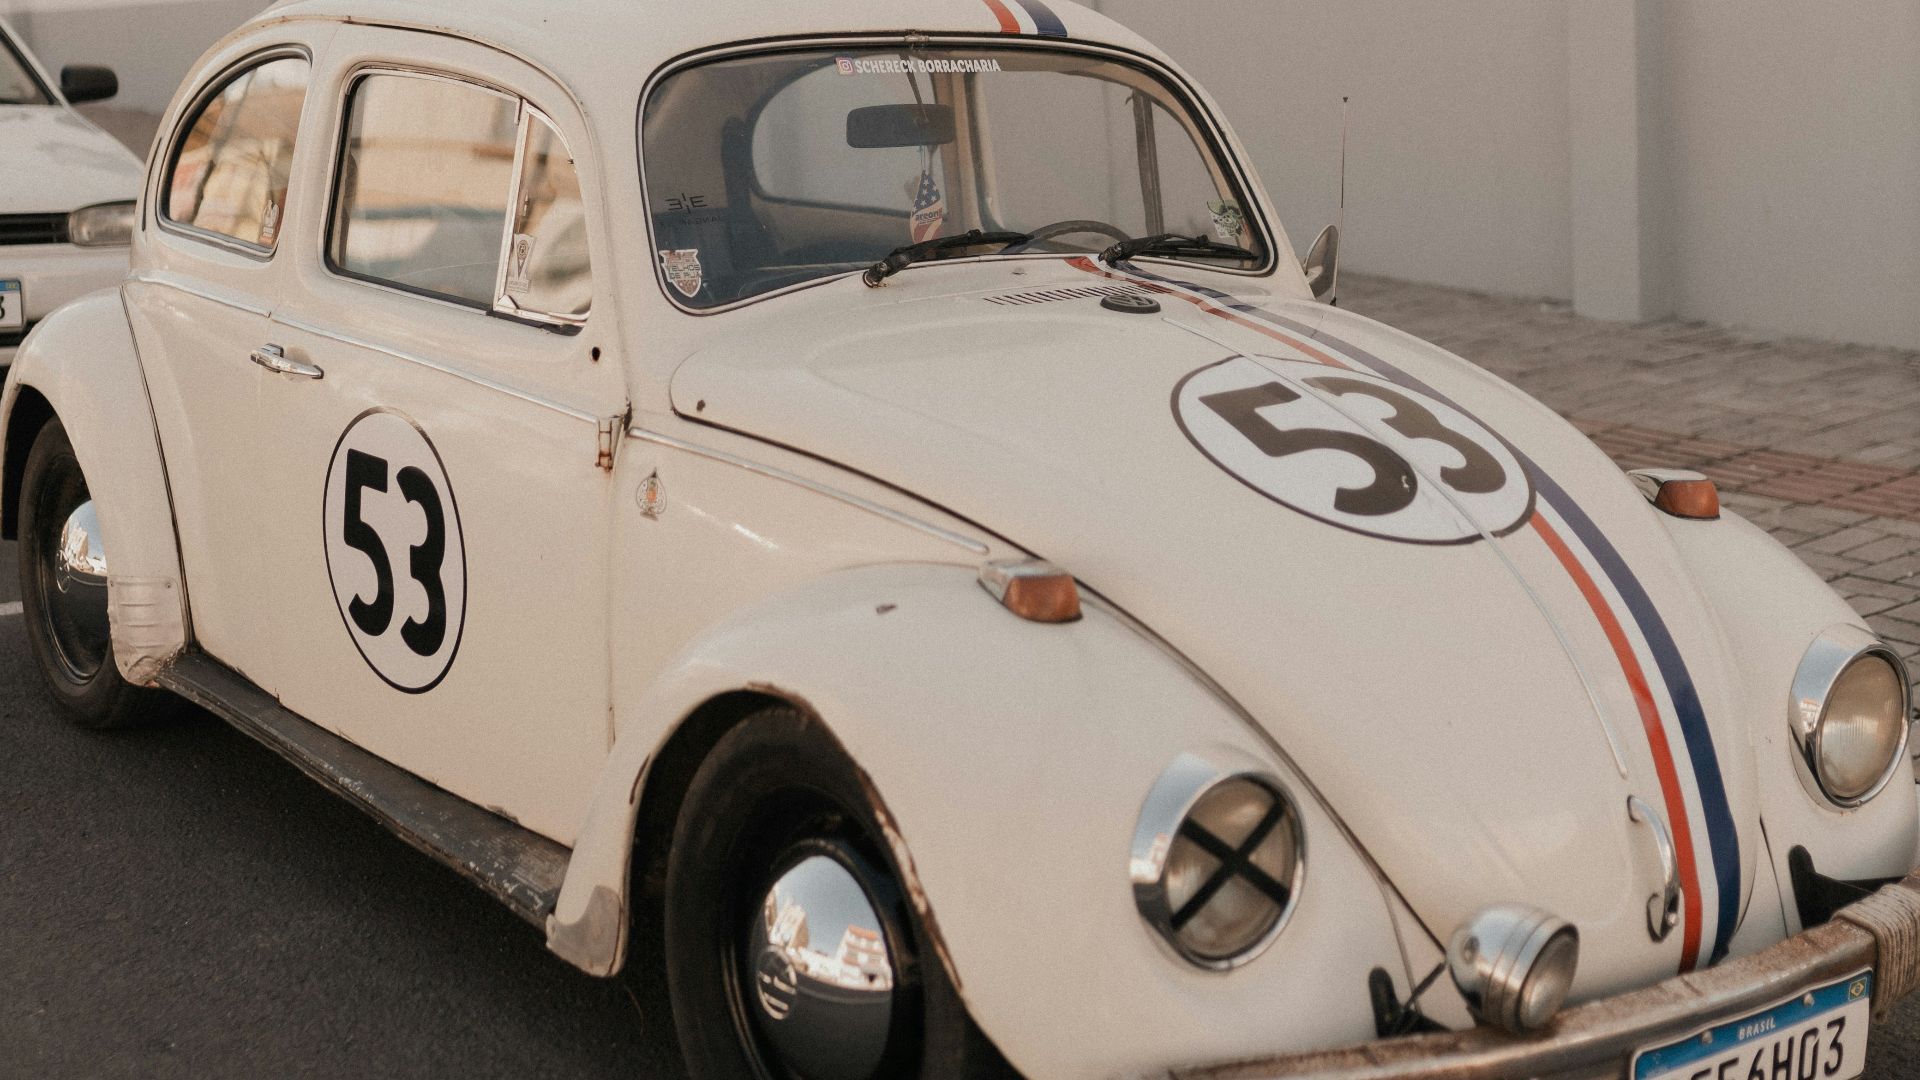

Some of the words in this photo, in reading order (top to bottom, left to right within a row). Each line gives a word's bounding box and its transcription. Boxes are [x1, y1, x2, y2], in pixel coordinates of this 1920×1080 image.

[855, 59, 917, 74] SCHERECK
[918, 58, 1001, 73] BORRACHARIA
[1197, 376, 1507, 517] 53
[343, 447, 447, 657] 53
[1690, 1016, 1846, 1080] 6H03
[1739, 1017, 1777, 1041] BRASIL
